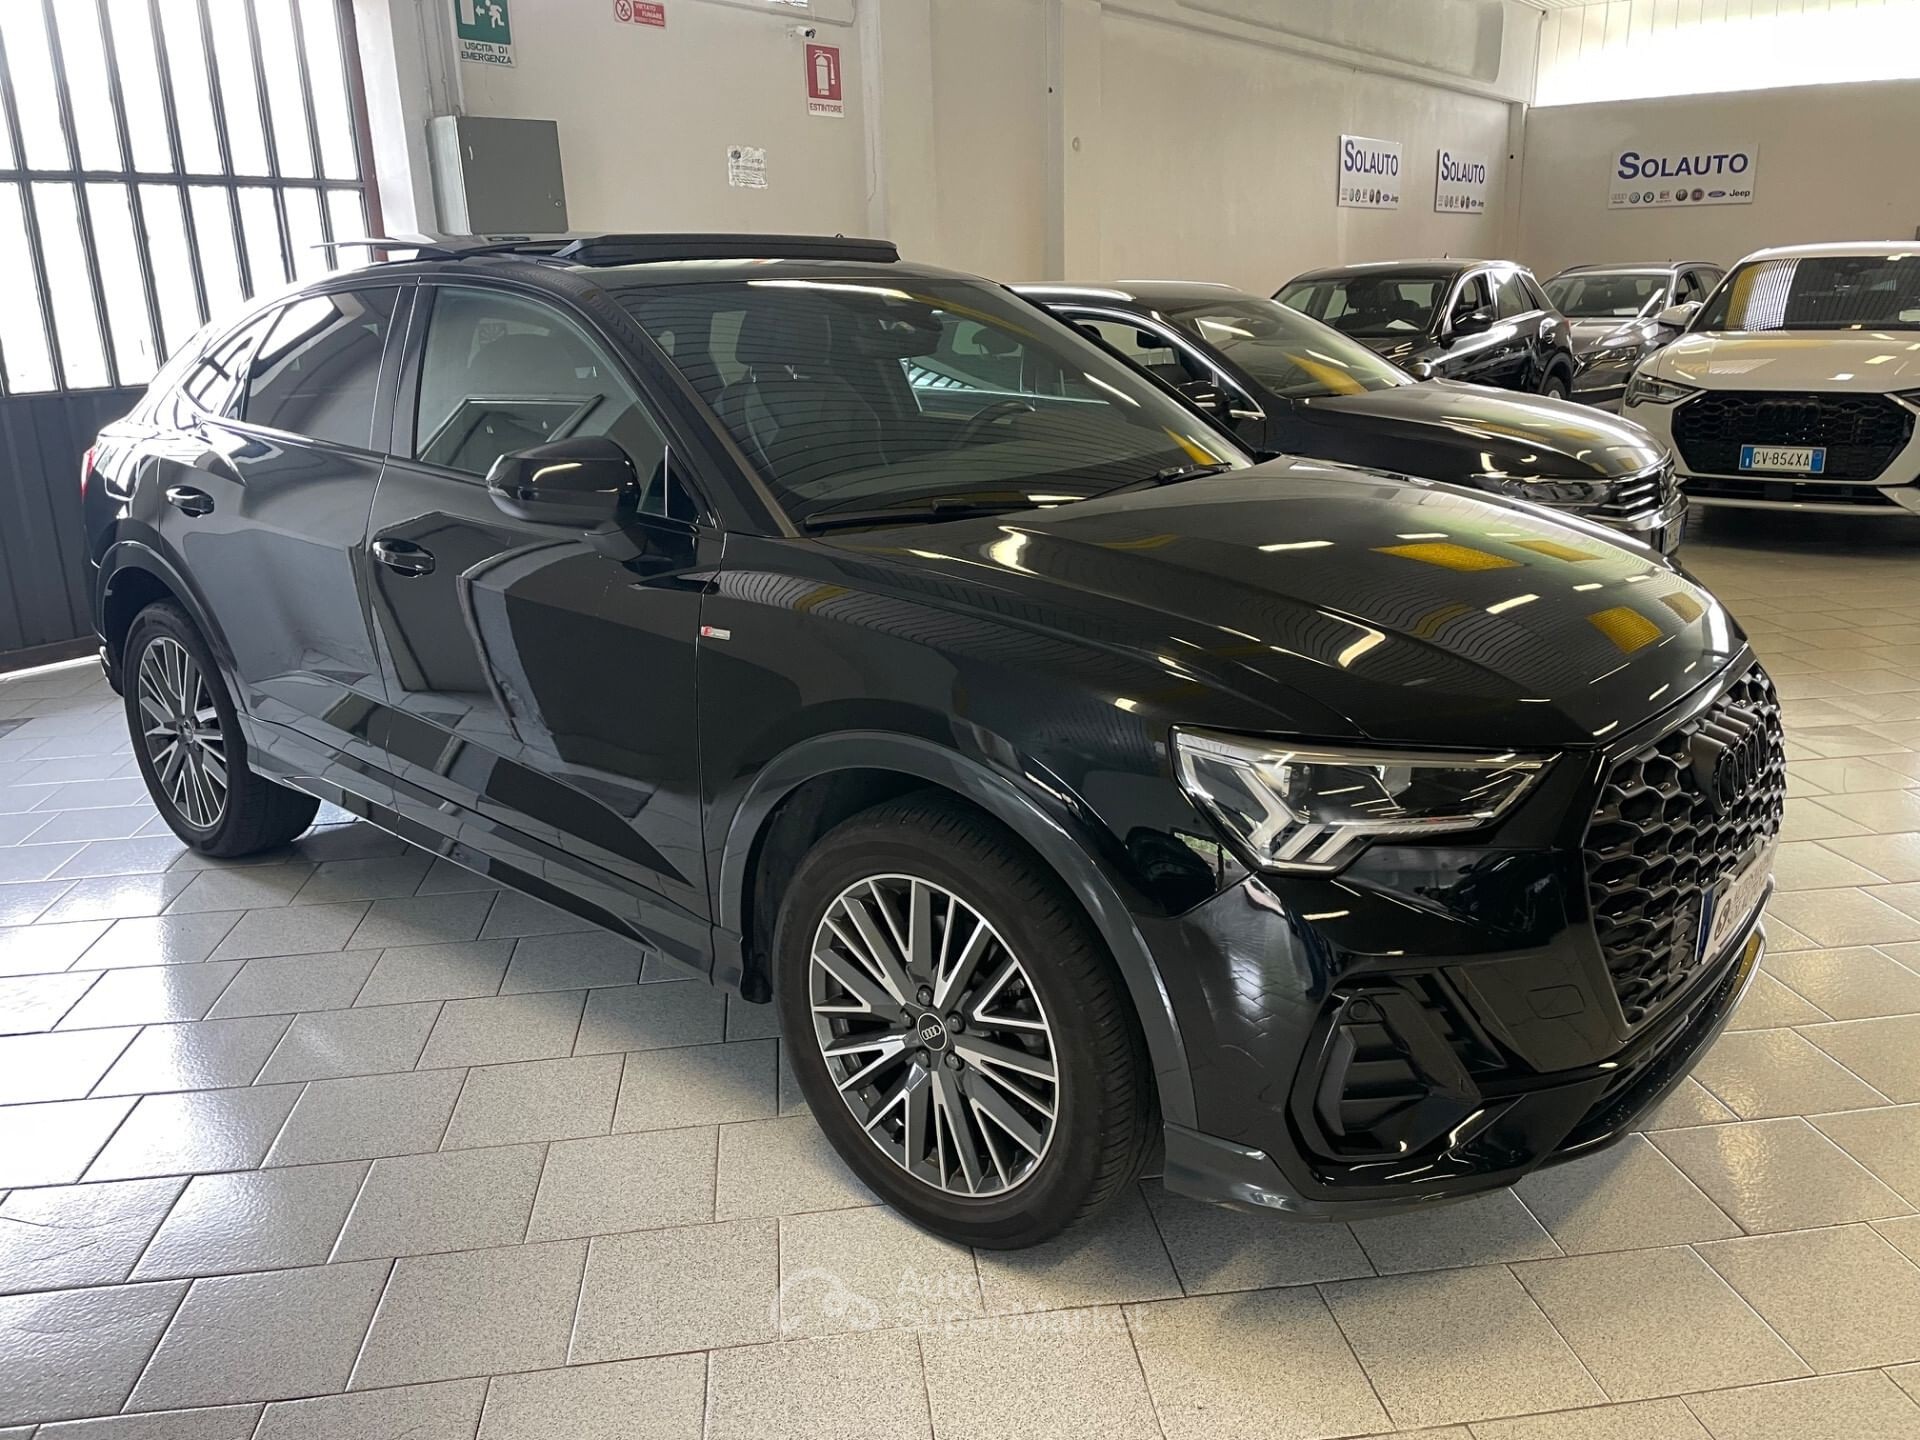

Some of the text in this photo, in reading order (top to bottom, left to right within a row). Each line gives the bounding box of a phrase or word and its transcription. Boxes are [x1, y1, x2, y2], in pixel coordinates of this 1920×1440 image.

[464, 42, 508, 54] USCITA DI
[461, 51, 513, 64] EMERGENZA
[809, 102, 842, 113] ESTINTORE
[1729, 189, 1750, 197] Jeep
